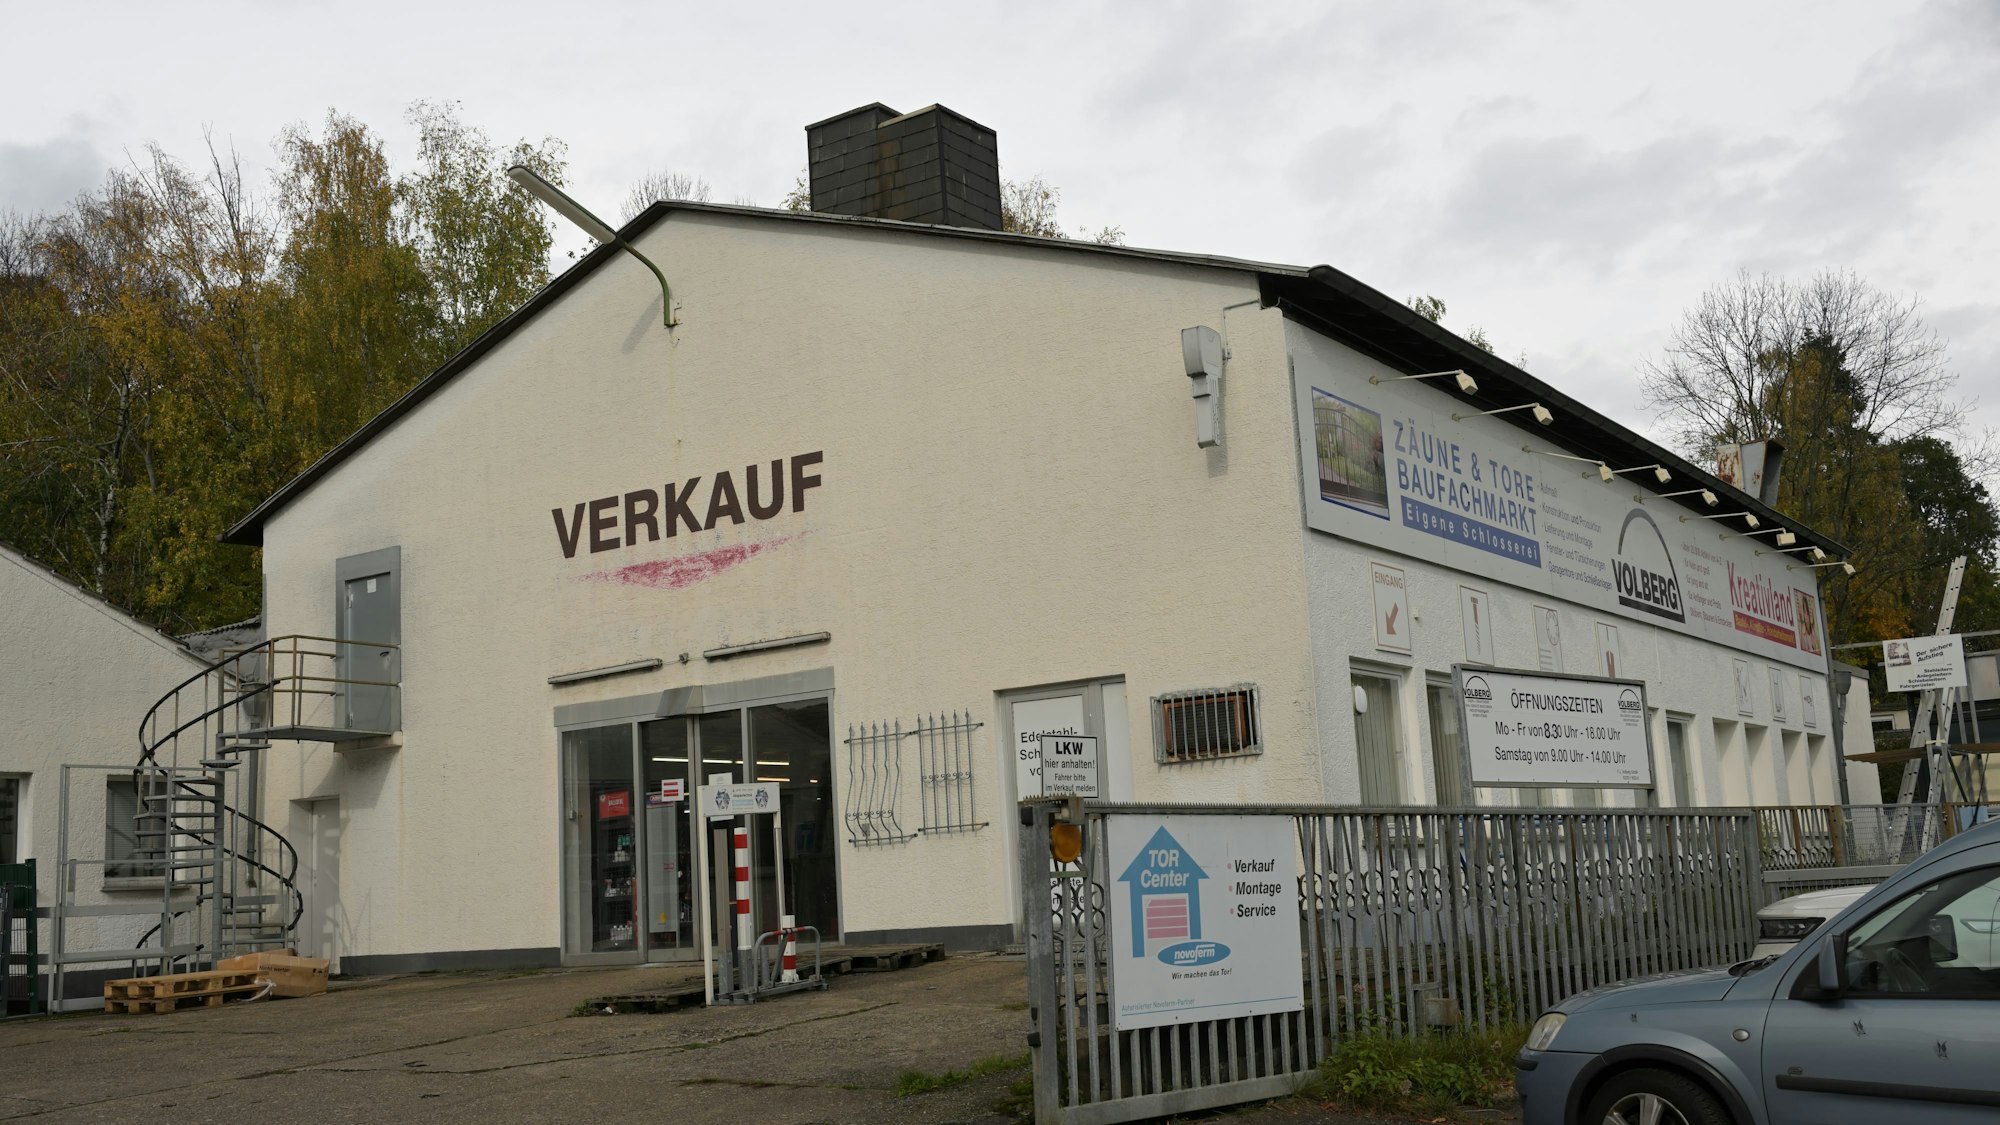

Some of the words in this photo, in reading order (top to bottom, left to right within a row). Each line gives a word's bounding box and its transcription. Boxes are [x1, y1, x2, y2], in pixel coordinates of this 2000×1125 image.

[1393, 418, 1462, 475] ZÄUNE
[1471, 452, 1482, 482] &
[1489, 460, 1536, 503] TORE
[551, 450, 824, 559] VERKAUF
[1397, 458, 1537, 535] BAUFACHMARKT
[1542, 502, 1570, 521] Konstruktion
[1571, 514, 1580, 526] und
[1405, 502, 1455, 534] Eigene
[1462, 521, 1538, 561] Schlosserei
[1544, 521, 1565, 541] Lieferung
[1565, 531, 1574, 542] und
[1574, 531, 1593, 550] Montage
[1566, 549, 1574, 561] und
[1374, 571, 1404, 590] EINGANG
[1549, 561, 1575, 578] Garagentore
[1575, 571, 1583, 582] und
[1611, 558, 1678, 611] VOLBERG
[1726, 560, 1795, 627] Kreativland
[1915, 650, 1928, 658] Der
[1929, 642, 1954, 653] sichere
[1917, 651, 1944, 663] Aufstieg
[1463, 688, 1491, 698] VOLBERG
[1510, 688, 1604, 714] ÖFFNUNGSZEITEN
[1618, 700, 1640, 709] VOLBERG
[1495, 721, 1510, 735] Mo
[1517, 722, 1526, 736] Fr
[1528, 726, 1544, 737] von
[1544, 722, 1562, 739] 8.30
[1564, 725, 1578, 739] Uhr
[1585, 726, 1606, 740] 18.00
[1607, 727, 1621, 740] Uhr
[1055, 741, 1083, 755] LKW
[1494, 746, 1533, 764] Samstag
[1534, 751, 1550, 762] von
[1551, 748, 1568, 762] 9.00
[1569, 749, 1584, 763] Uhr
[1591, 750, 1611, 763] 14.00
[1612, 751, 1626, 764] Uhr
[1044, 758, 1060, 769] hier
[1061, 759, 1096, 769] anhalten!
[1054, 773, 1073, 782] Fahrer
[1073, 773, 1086, 782] bitte
[1045, 784, 1053, 792] im
[1054, 784, 1075, 792] Verkauf
[1075, 784, 1096, 792] melden
[1148, 849, 1180, 868] TOR
[1234, 859, 1275, 873] Verkauf
[1140, 869, 1190, 888] Center
[1236, 881, 1282, 897] Montage
[1237, 903, 1277, 918] Service
[1173, 943, 1216, 964] novoferm
[1172, 971, 1182, 980] Wir
[1184, 971, 1208, 979] machen
[1209, 969, 1220, 978] das
[1221, 967, 1233, 976] Tor!
